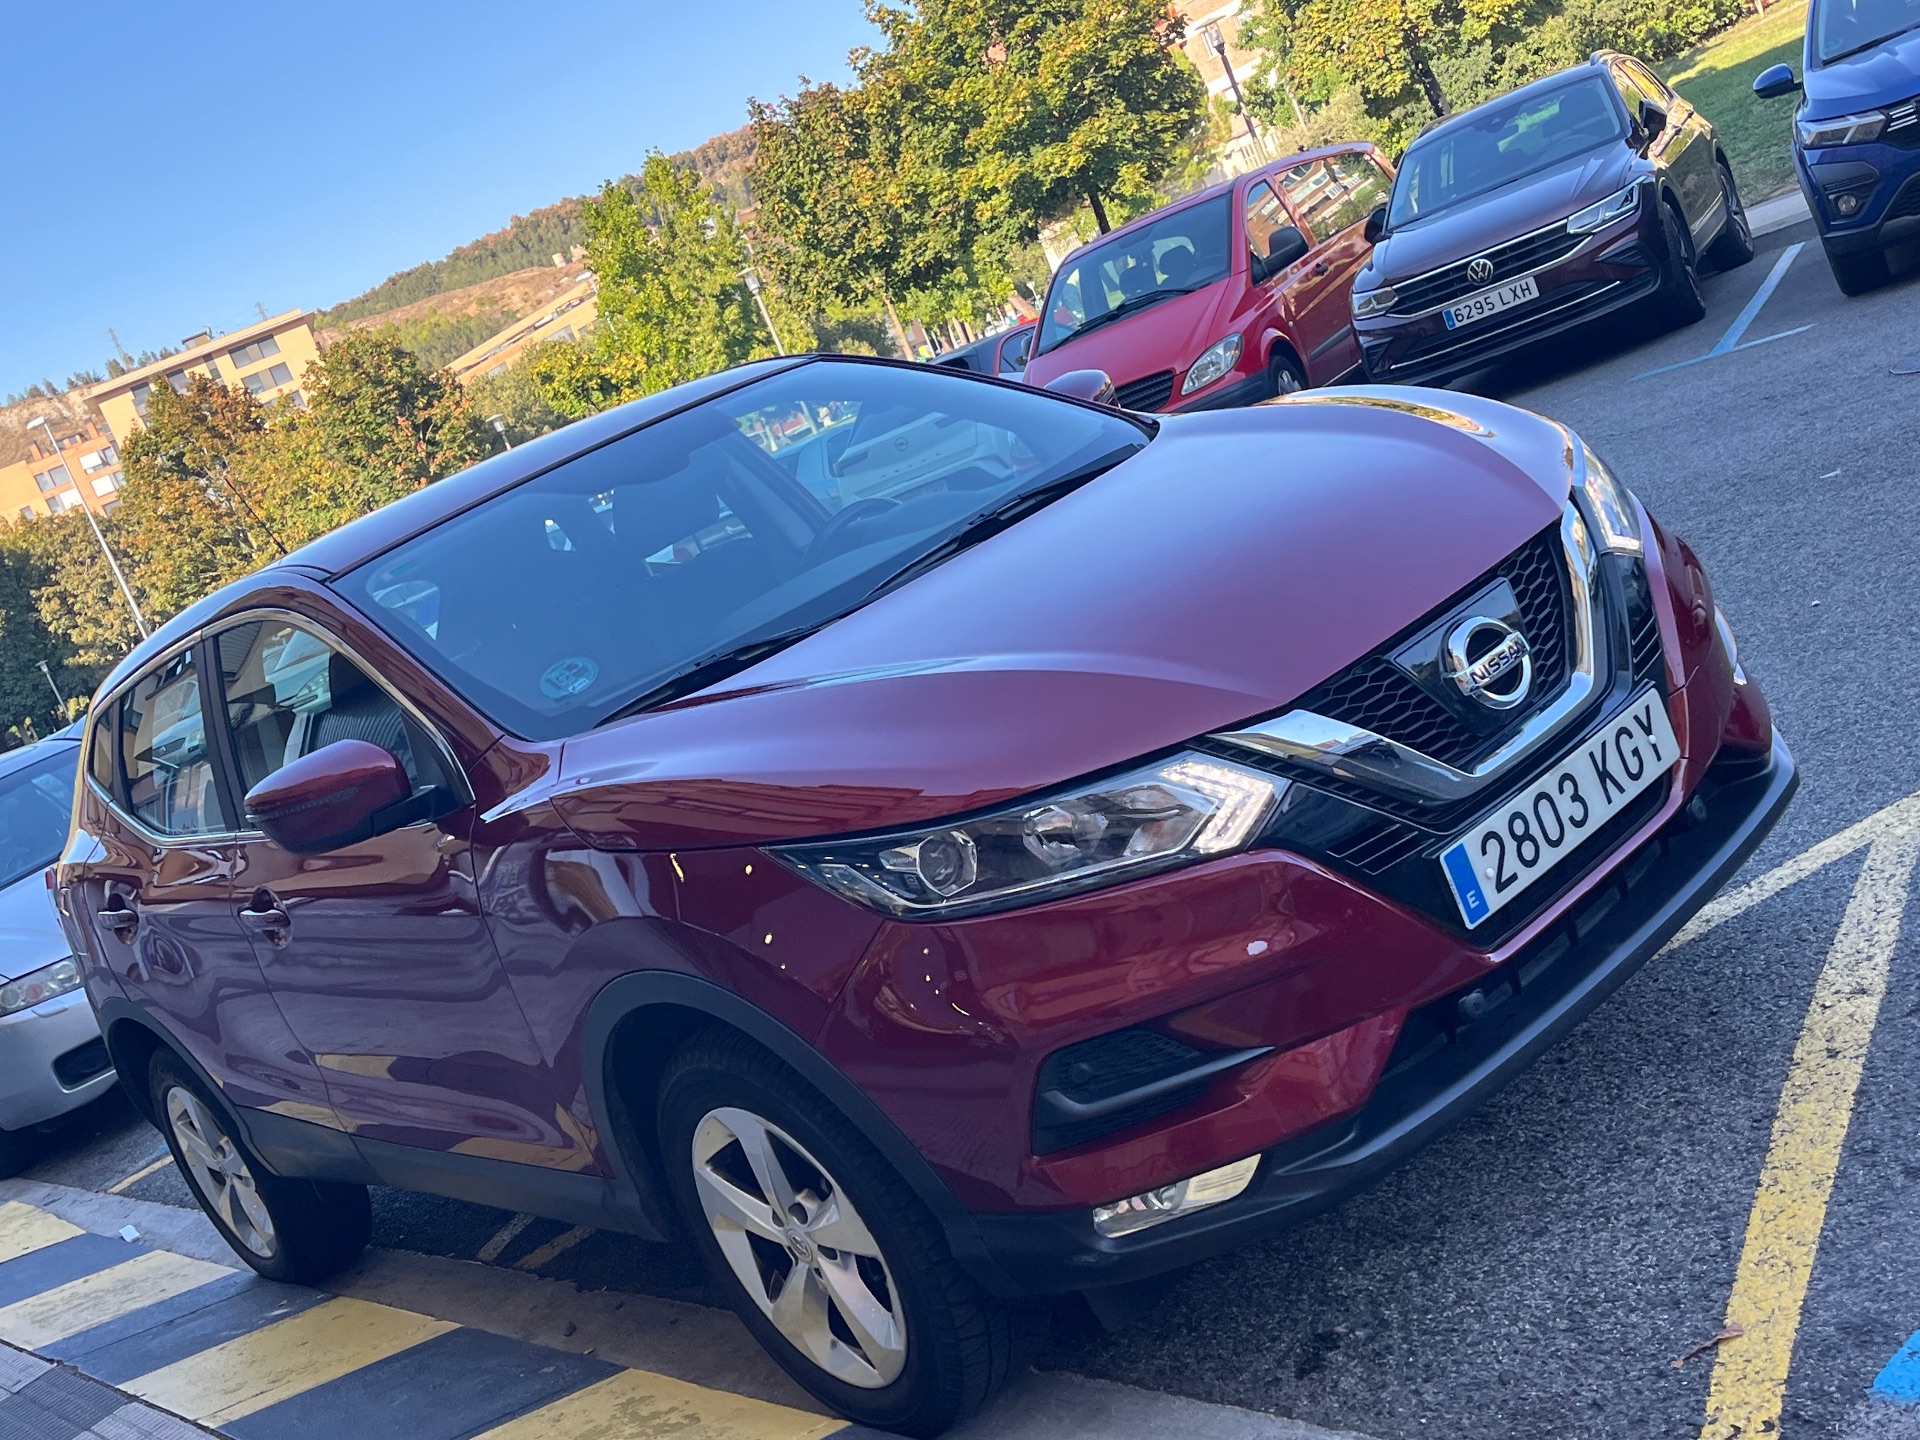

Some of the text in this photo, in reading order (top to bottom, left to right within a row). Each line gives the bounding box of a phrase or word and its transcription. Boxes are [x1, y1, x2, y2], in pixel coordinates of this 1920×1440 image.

[1453, 281, 1532, 323] 6295 LXH
[1469, 640, 1527, 685] NISSAN
[1480, 704, 1662, 894] 2803 KGY
[1466, 889, 1480, 909] E
